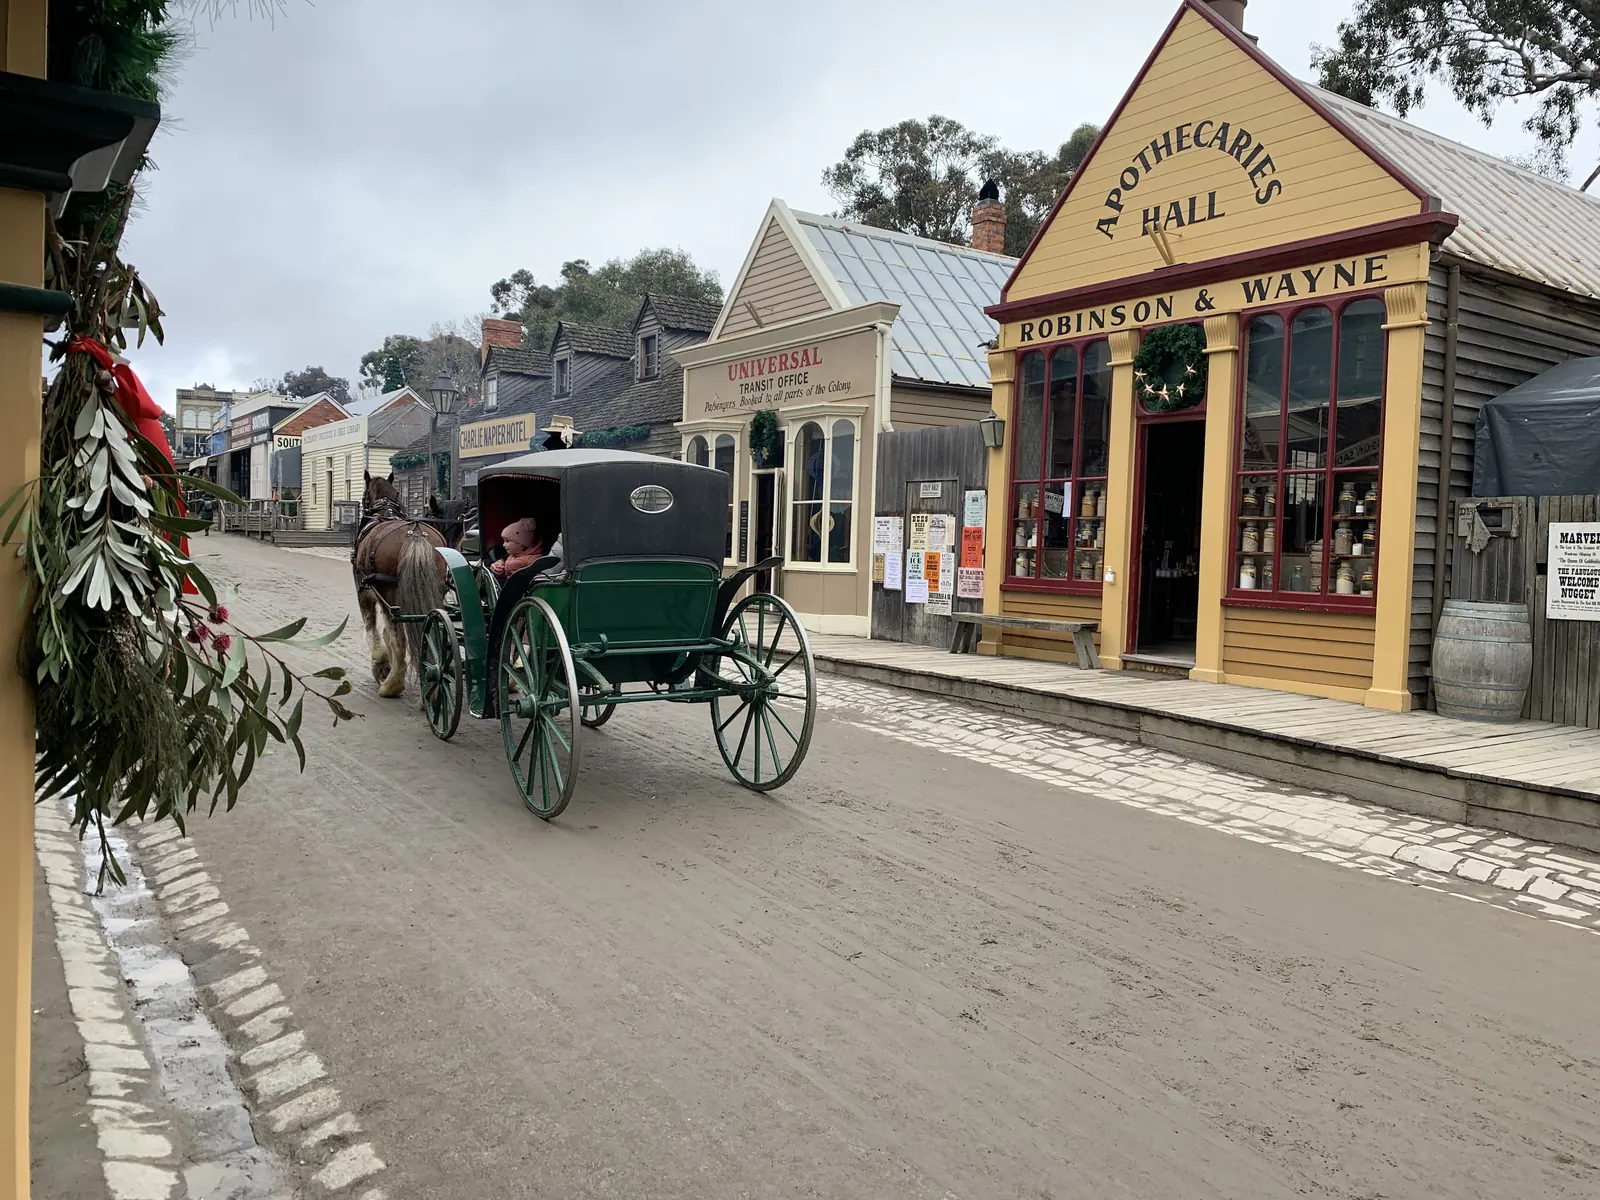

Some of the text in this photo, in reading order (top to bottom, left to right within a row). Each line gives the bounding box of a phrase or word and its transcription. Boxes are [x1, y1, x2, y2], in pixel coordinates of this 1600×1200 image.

[1096, 120, 1282, 240] APOTHECARIES
[1141, 190, 1226, 237] HALL
[1020, 254, 1388, 343] ROBINSON & WAYNE
[728, 346, 823, 382] UNIVERSAL
[740, 371, 809, 395] TRANSIT OFFICE
[774, 389, 784, 401] all
[784, 387, 803, 402] parts
[805, 384, 814, 397] of
[815, 383, 826, 395] the
[277, 437, 303, 449] SOUT
[460, 427, 483, 450] CHARLIE
[484, 423, 506, 447] NAPIER
[1558, 567, 1569, 575] THE
[1559, 576, 1599, 588] WELCOME
[1561, 588, 1596, 600] NUGGET
